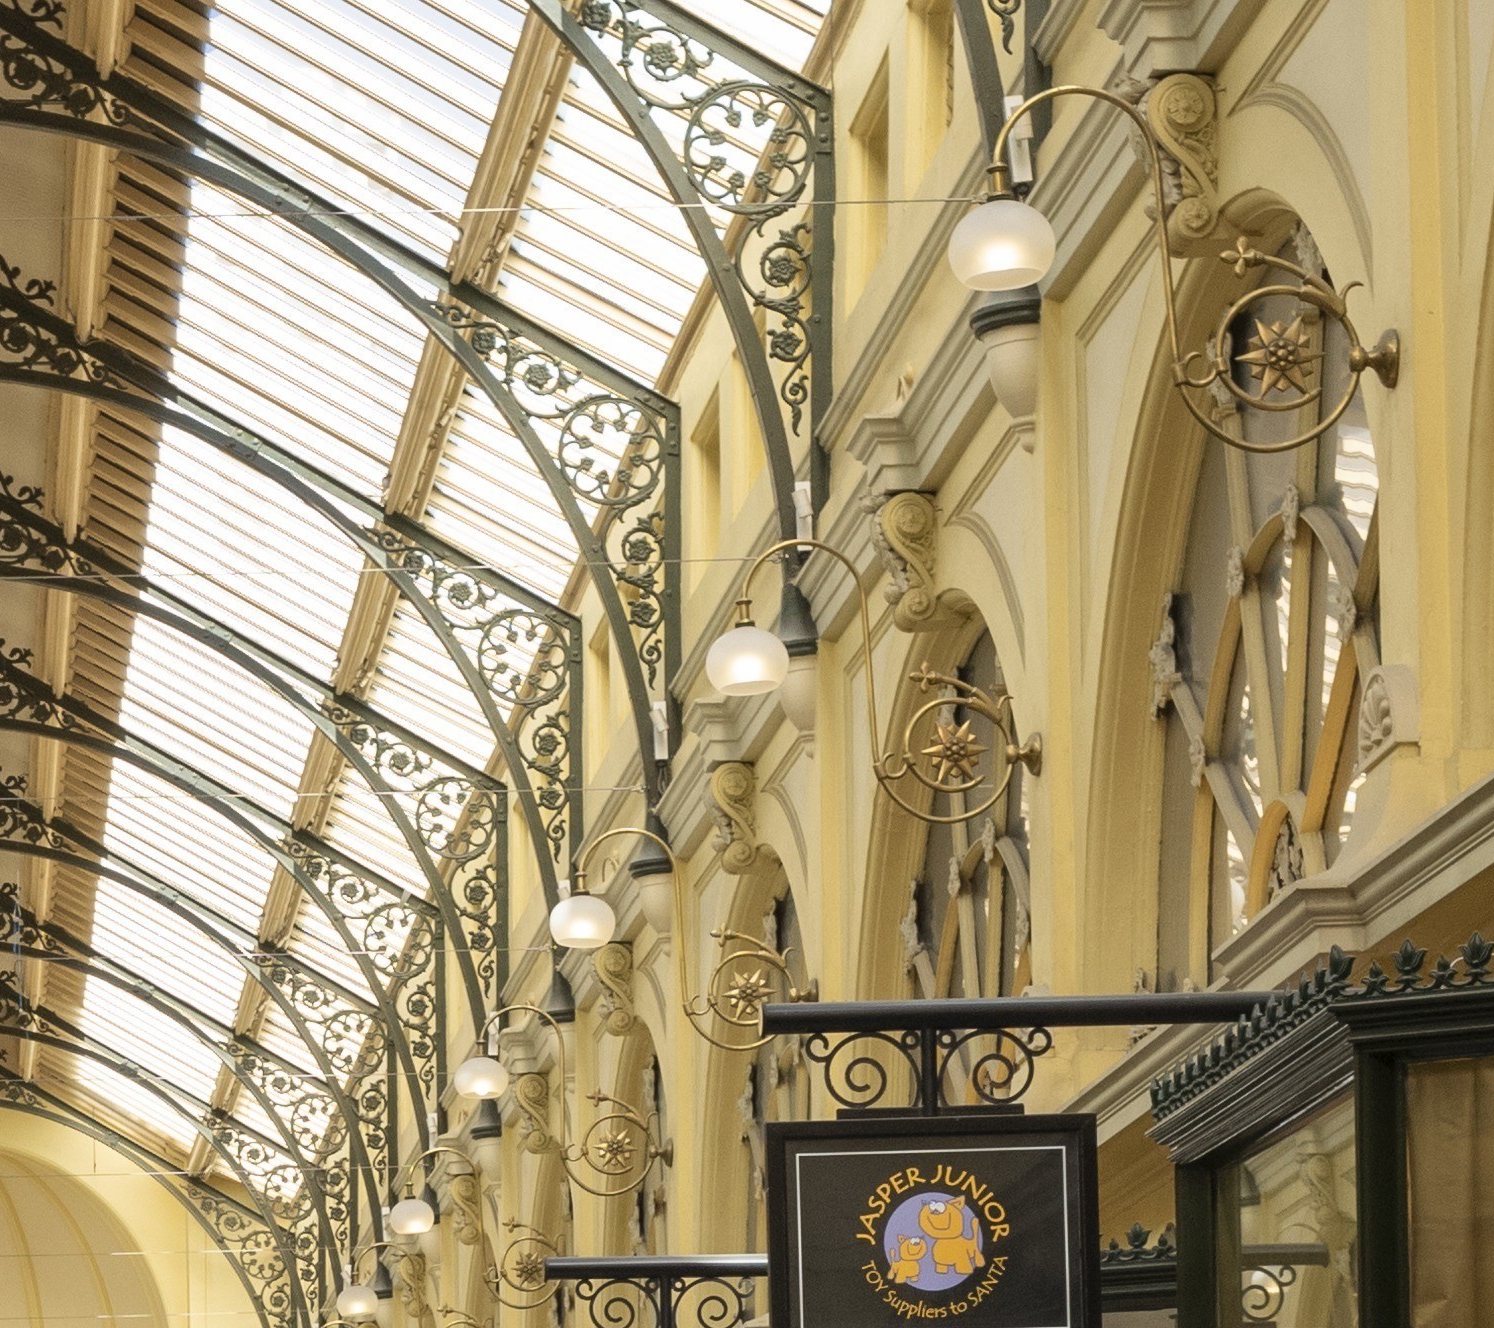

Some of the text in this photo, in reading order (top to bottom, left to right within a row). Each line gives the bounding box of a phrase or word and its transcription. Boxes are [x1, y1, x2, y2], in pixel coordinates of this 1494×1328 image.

[856, 1163, 1011, 1246] JASPER JUNIOR
[860, 1254, 1010, 1320] TOY Suppliers to SANTA
